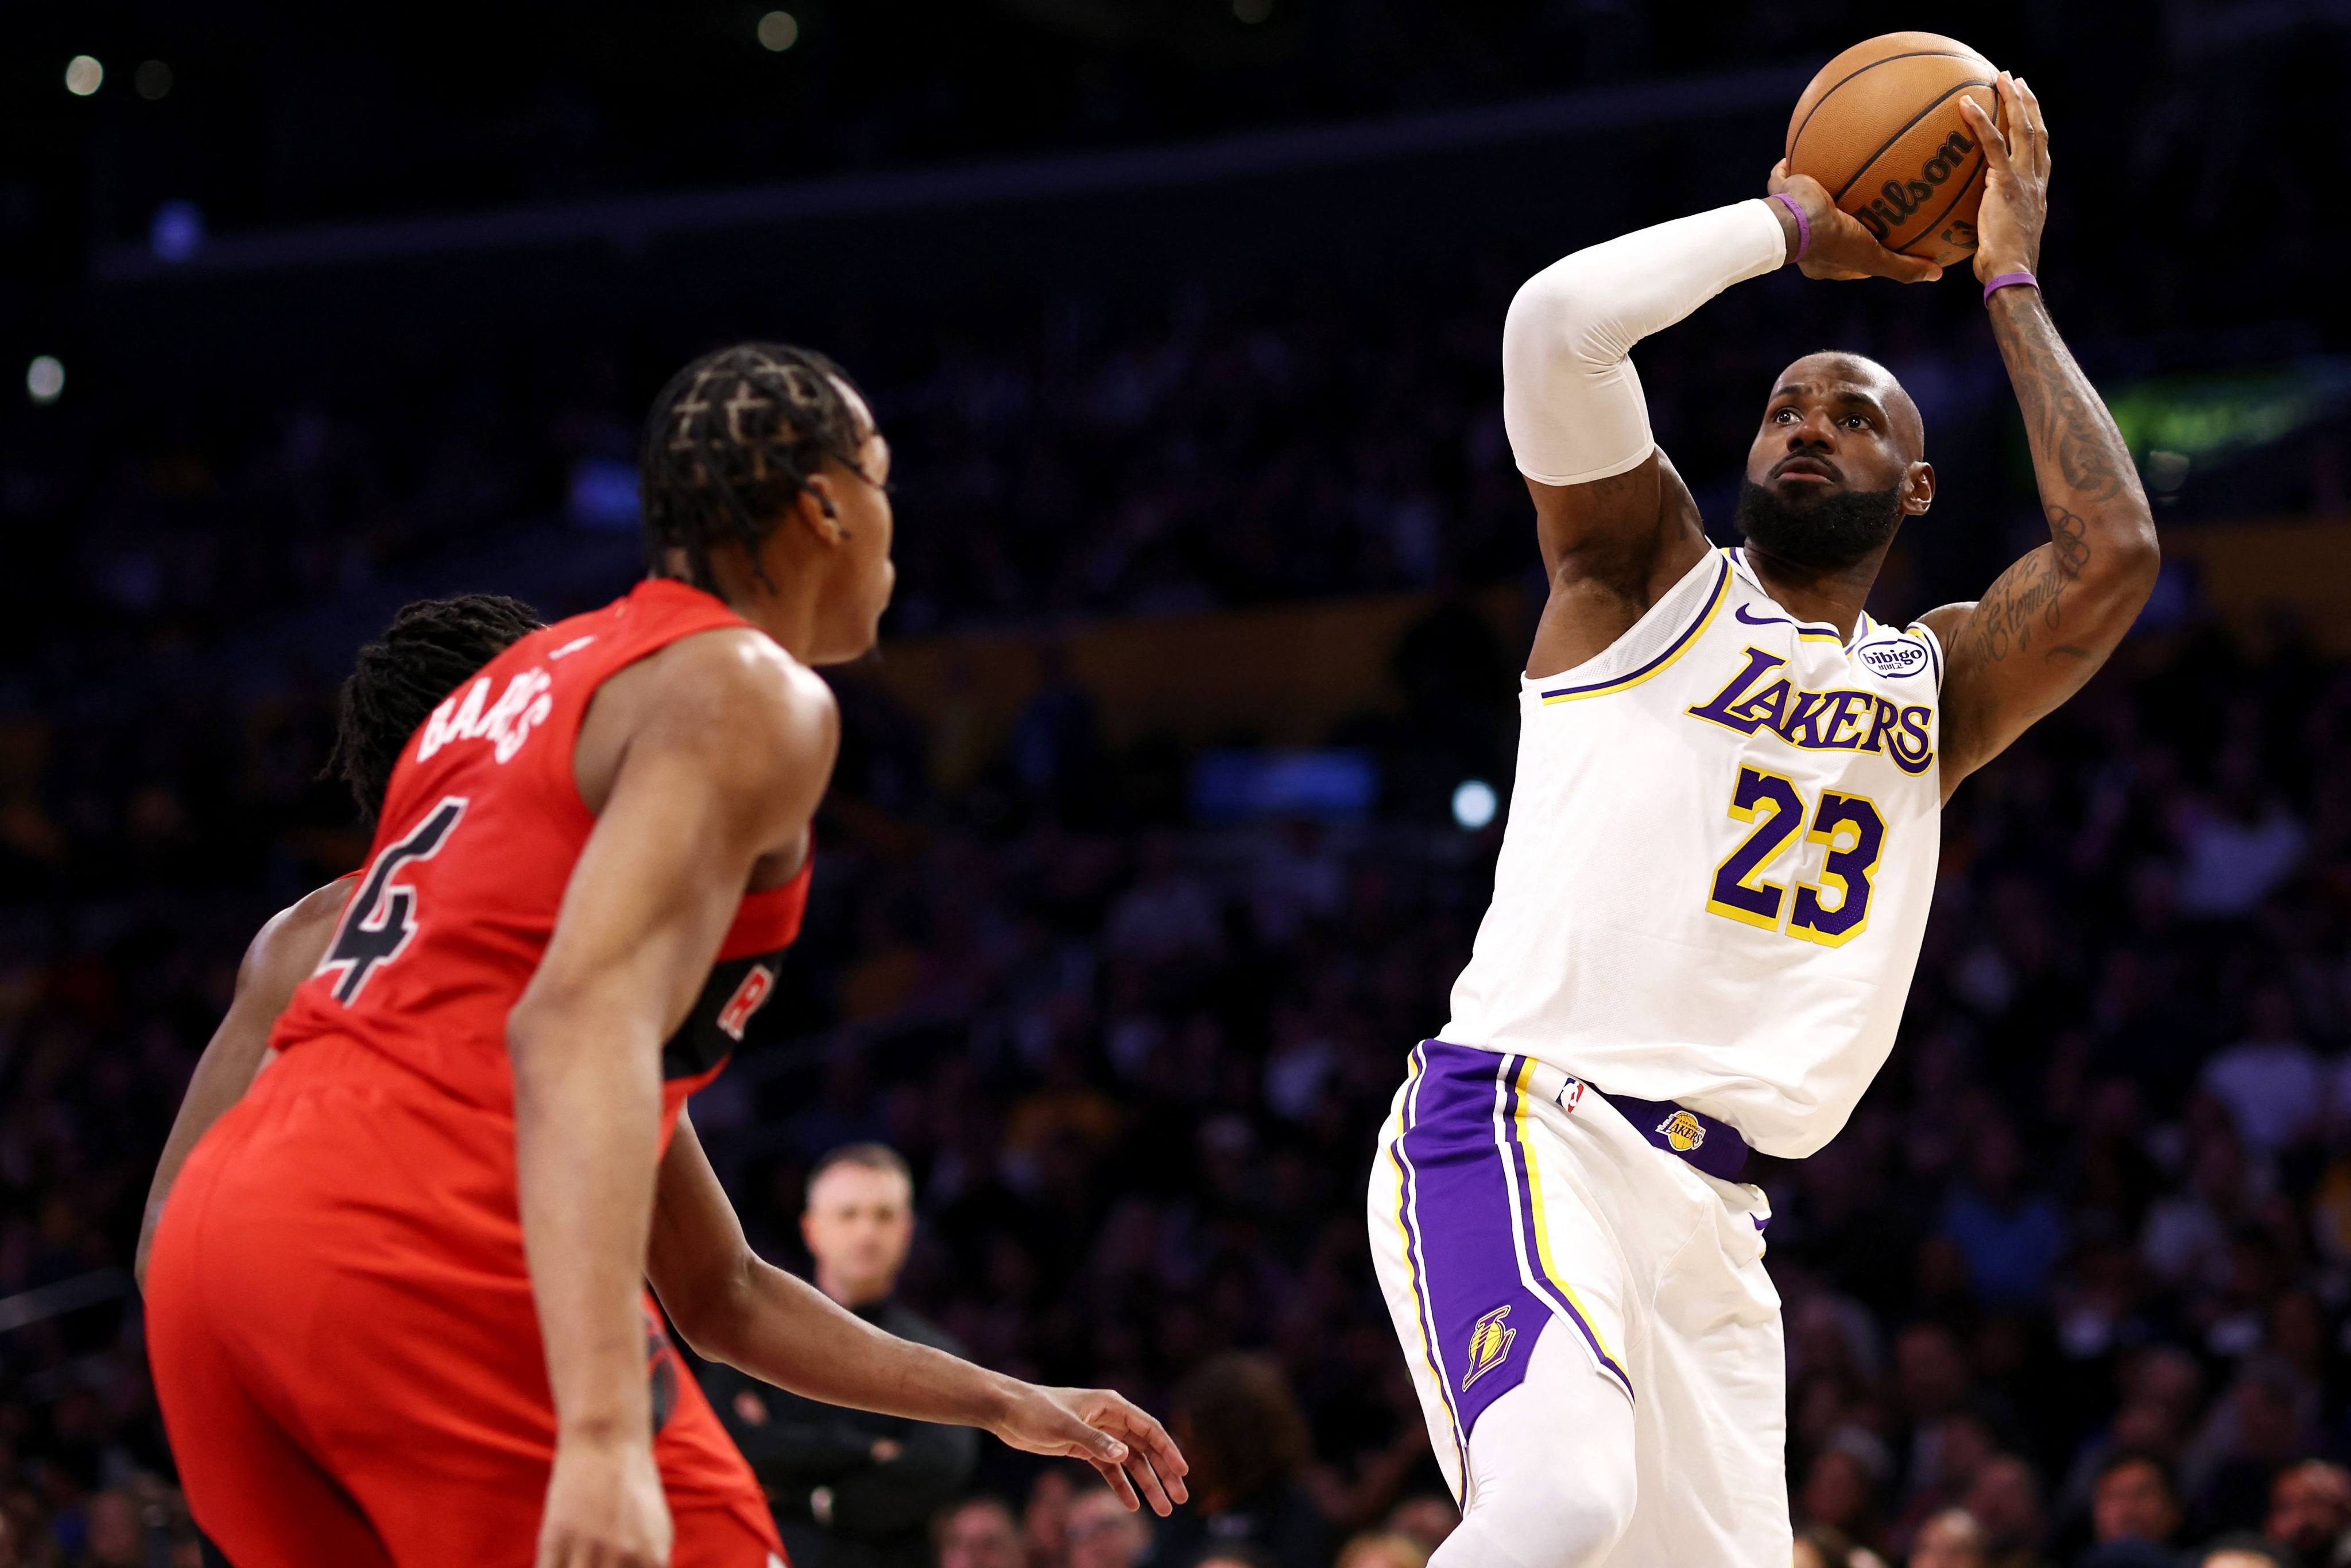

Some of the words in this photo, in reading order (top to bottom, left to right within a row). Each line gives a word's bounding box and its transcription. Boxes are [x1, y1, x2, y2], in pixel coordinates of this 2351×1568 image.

[1862, 649, 1923, 665] bibigo
[1878, 662, 1904, 670] 비비고
[1683, 645, 1935, 777] LAKERS
[1706, 762, 1889, 949] 23
[315, 796, 469, 1008] 4
[1659, 1115, 1703, 1148] LAKERS
